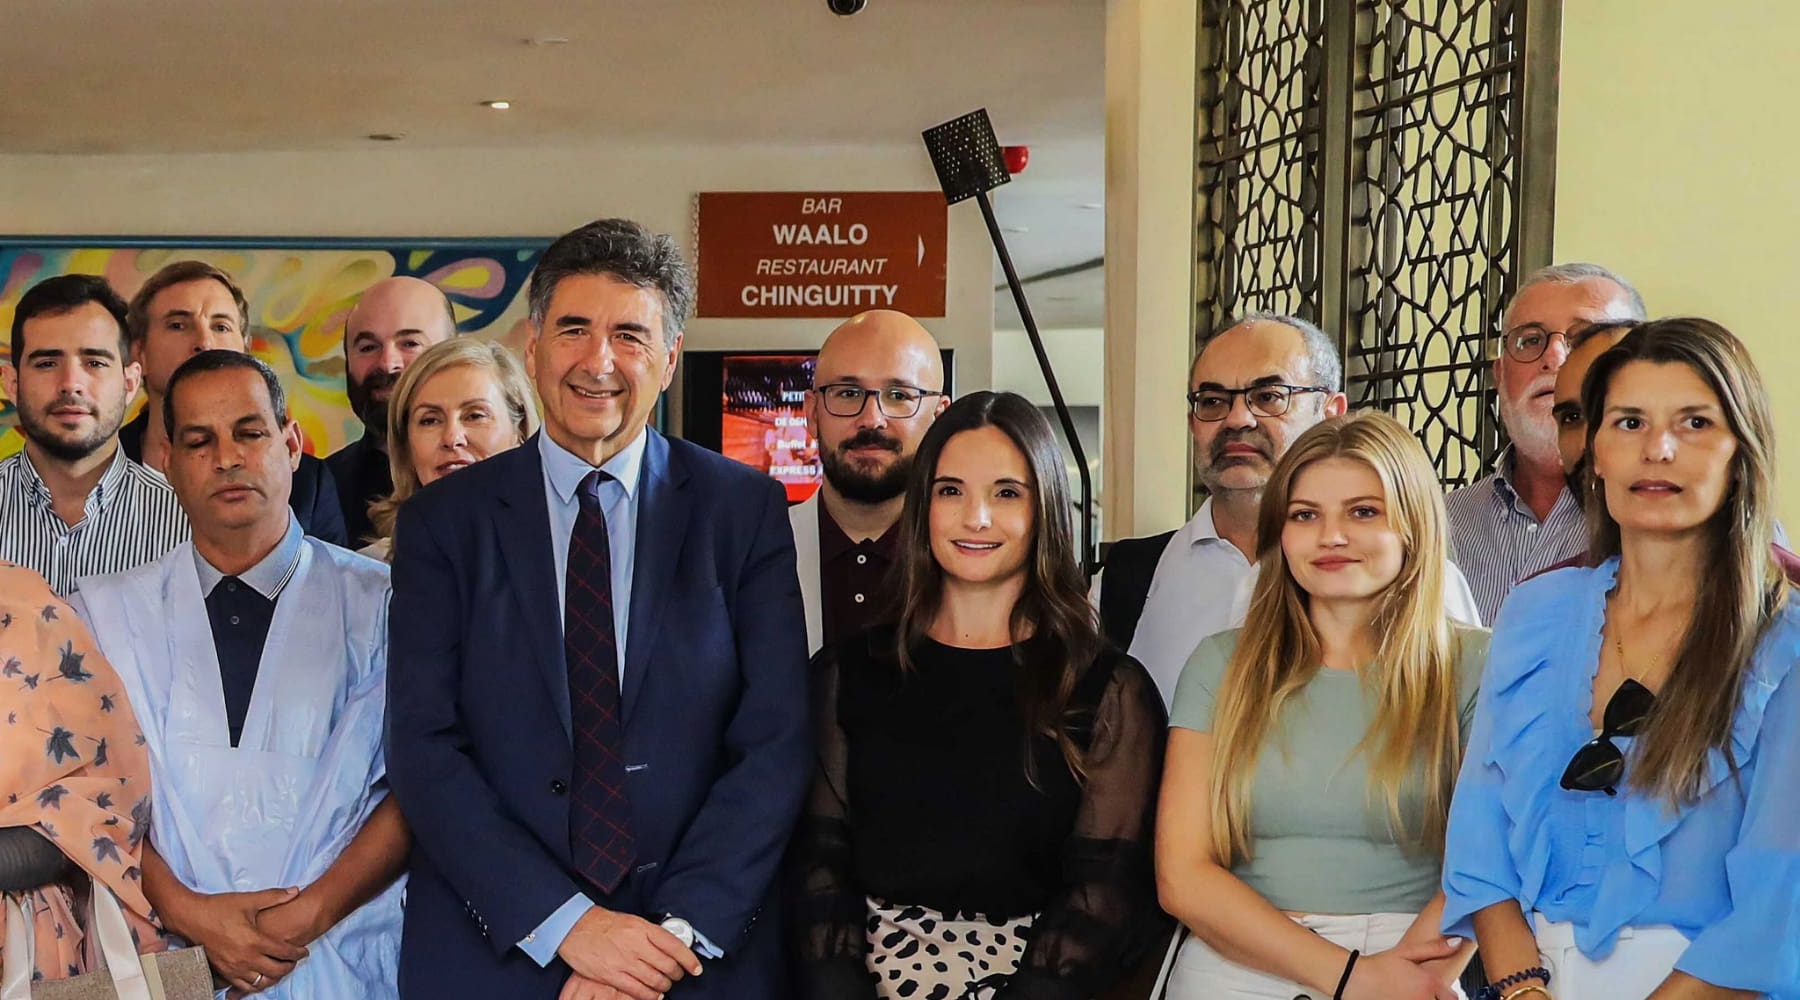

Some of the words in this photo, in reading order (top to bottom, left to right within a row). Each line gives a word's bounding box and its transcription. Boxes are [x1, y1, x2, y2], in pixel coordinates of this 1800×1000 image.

[801, 198, 843, 214] BAR
[772, 223, 869, 245] WAALO
[756, 258, 888, 276] RESTAURANT
[740, 284, 899, 307] CHINGUITTY
